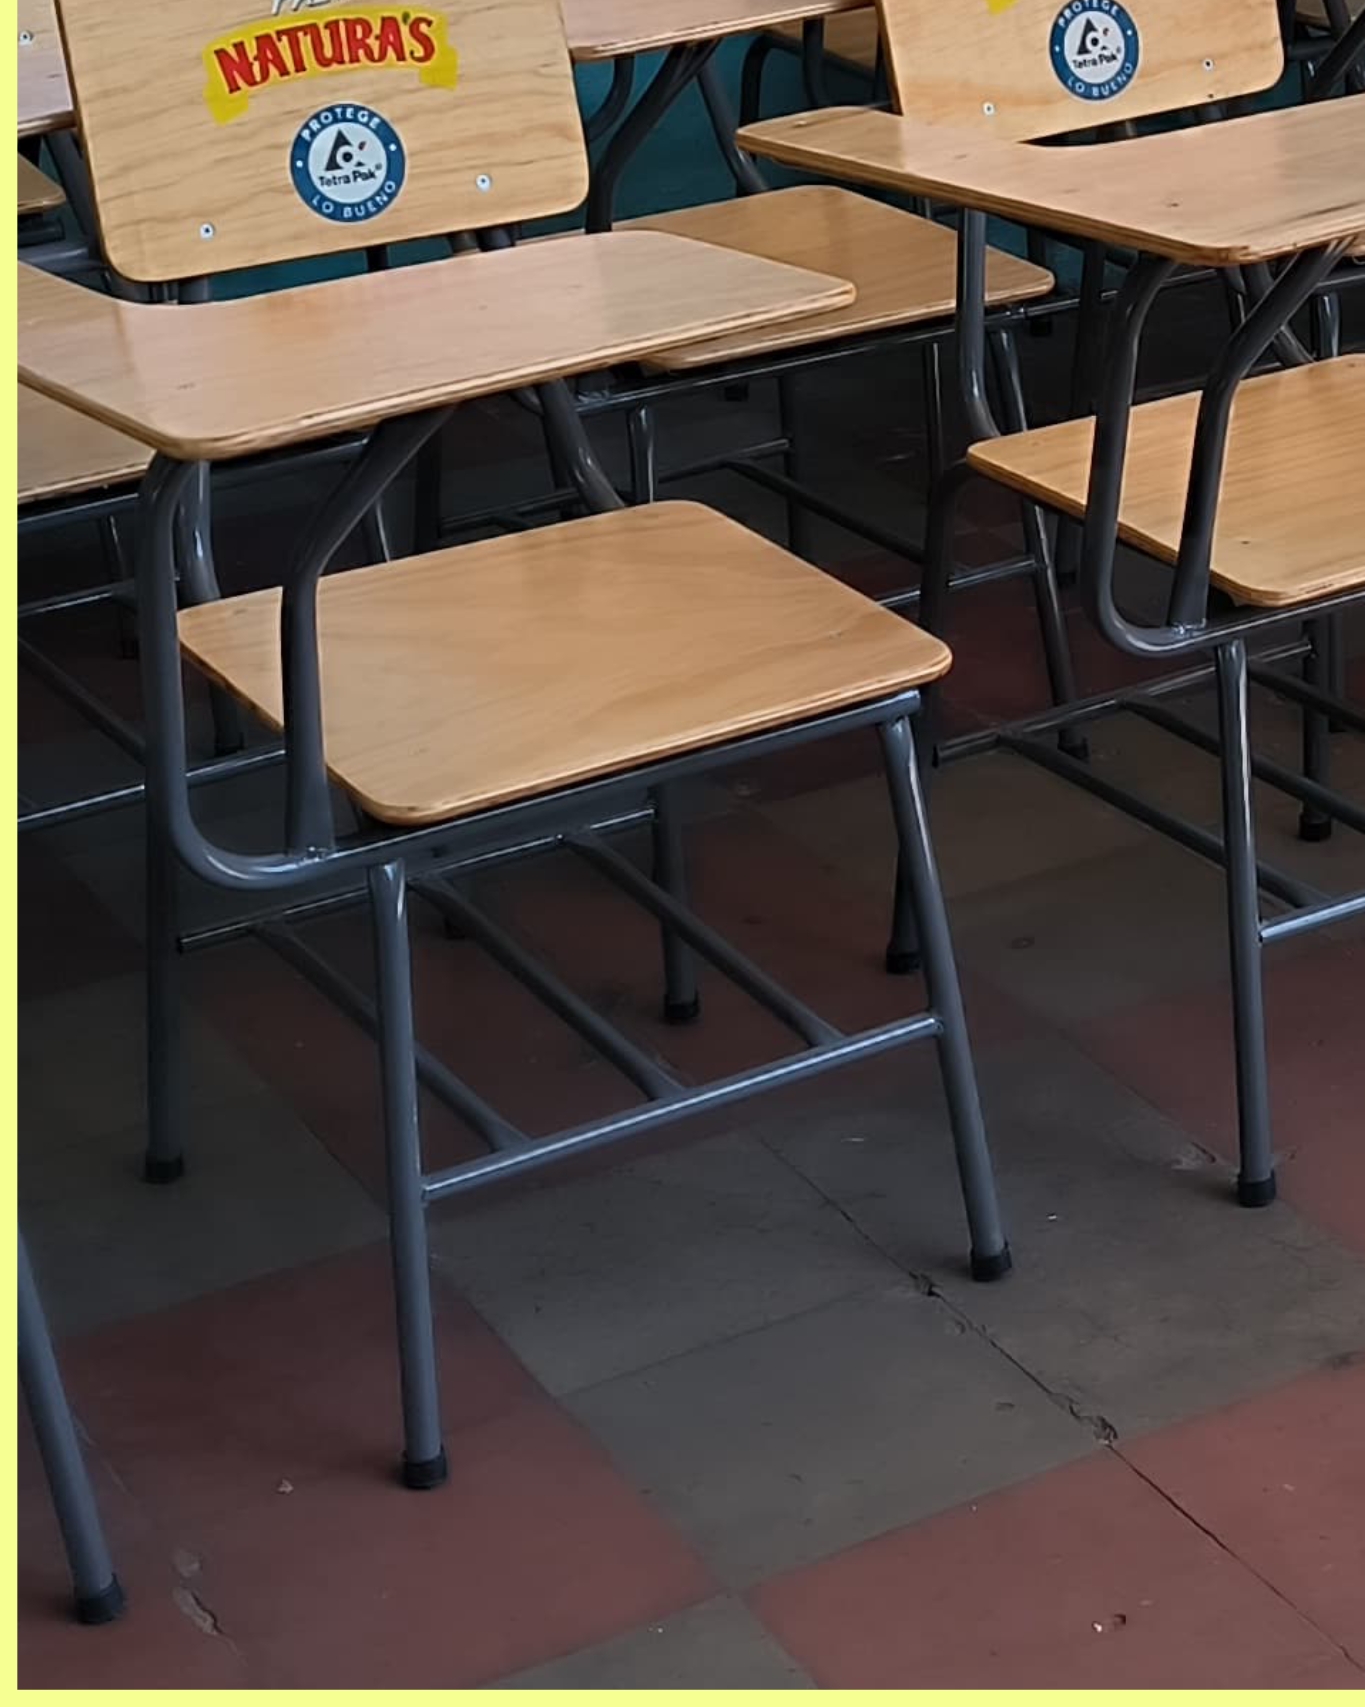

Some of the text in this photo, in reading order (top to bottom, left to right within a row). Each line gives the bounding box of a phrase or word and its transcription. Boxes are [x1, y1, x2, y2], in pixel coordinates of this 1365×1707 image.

[213, 17, 437, 93] NATURA'S
[1072, 46, 1121, 69] Tetra Pak
[1068, 62, 1133, 96] LO BUENO
[301, 108, 381, 142] PROTEGE
[318, 167, 383, 187] Tetra Pak
[312, 181, 396, 218] LO BUENO
